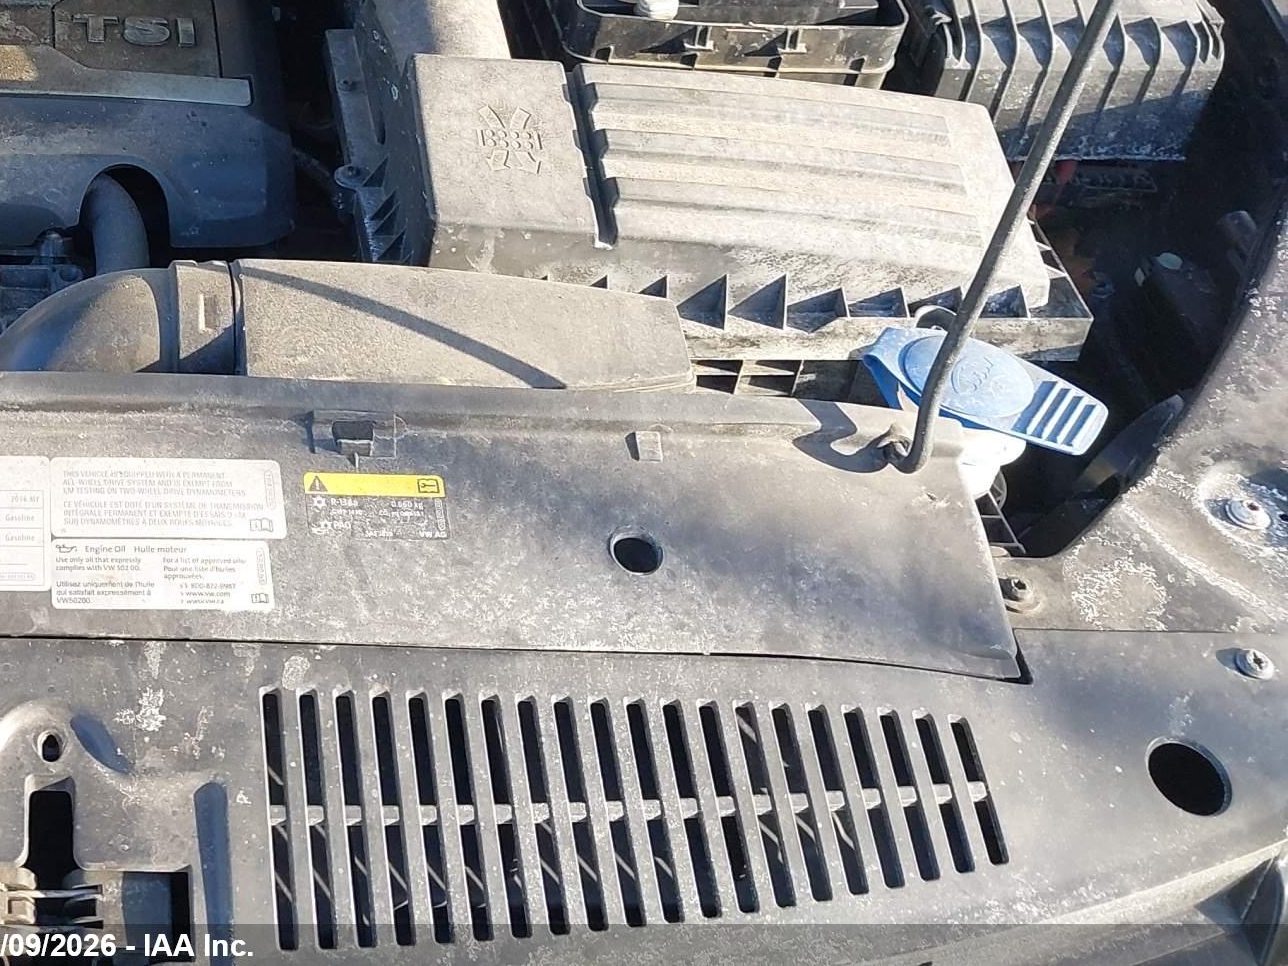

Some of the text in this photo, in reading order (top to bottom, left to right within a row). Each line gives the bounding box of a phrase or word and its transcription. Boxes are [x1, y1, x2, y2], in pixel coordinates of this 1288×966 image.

[72, 13, 197, 48] TSI
[5, 513, 35, 522] Gasoline
[5, 533, 36, 542] Gasoline
[418, 530, 432, 538] VW
[434, 530, 447, 538] AG
[84, 545, 126, 555] Engine Oil
[133, 545, 187, 554] Huile moteur
[55, 556, 68, 564] Use
[69, 556, 84, 565] only
[95, 556, 109, 564] that
[110, 557, 141, 566] expressly
[55, 564, 86, 573] complies
[86, 564, 102, 572] with
[103, 564, 116, 572] VW
[55, 580, 81, 589] Utilisez
[124, 581, 134, 589] de
[55, 589, 67, 597] qui
[185, 590, 231, 598] www.vw.com
